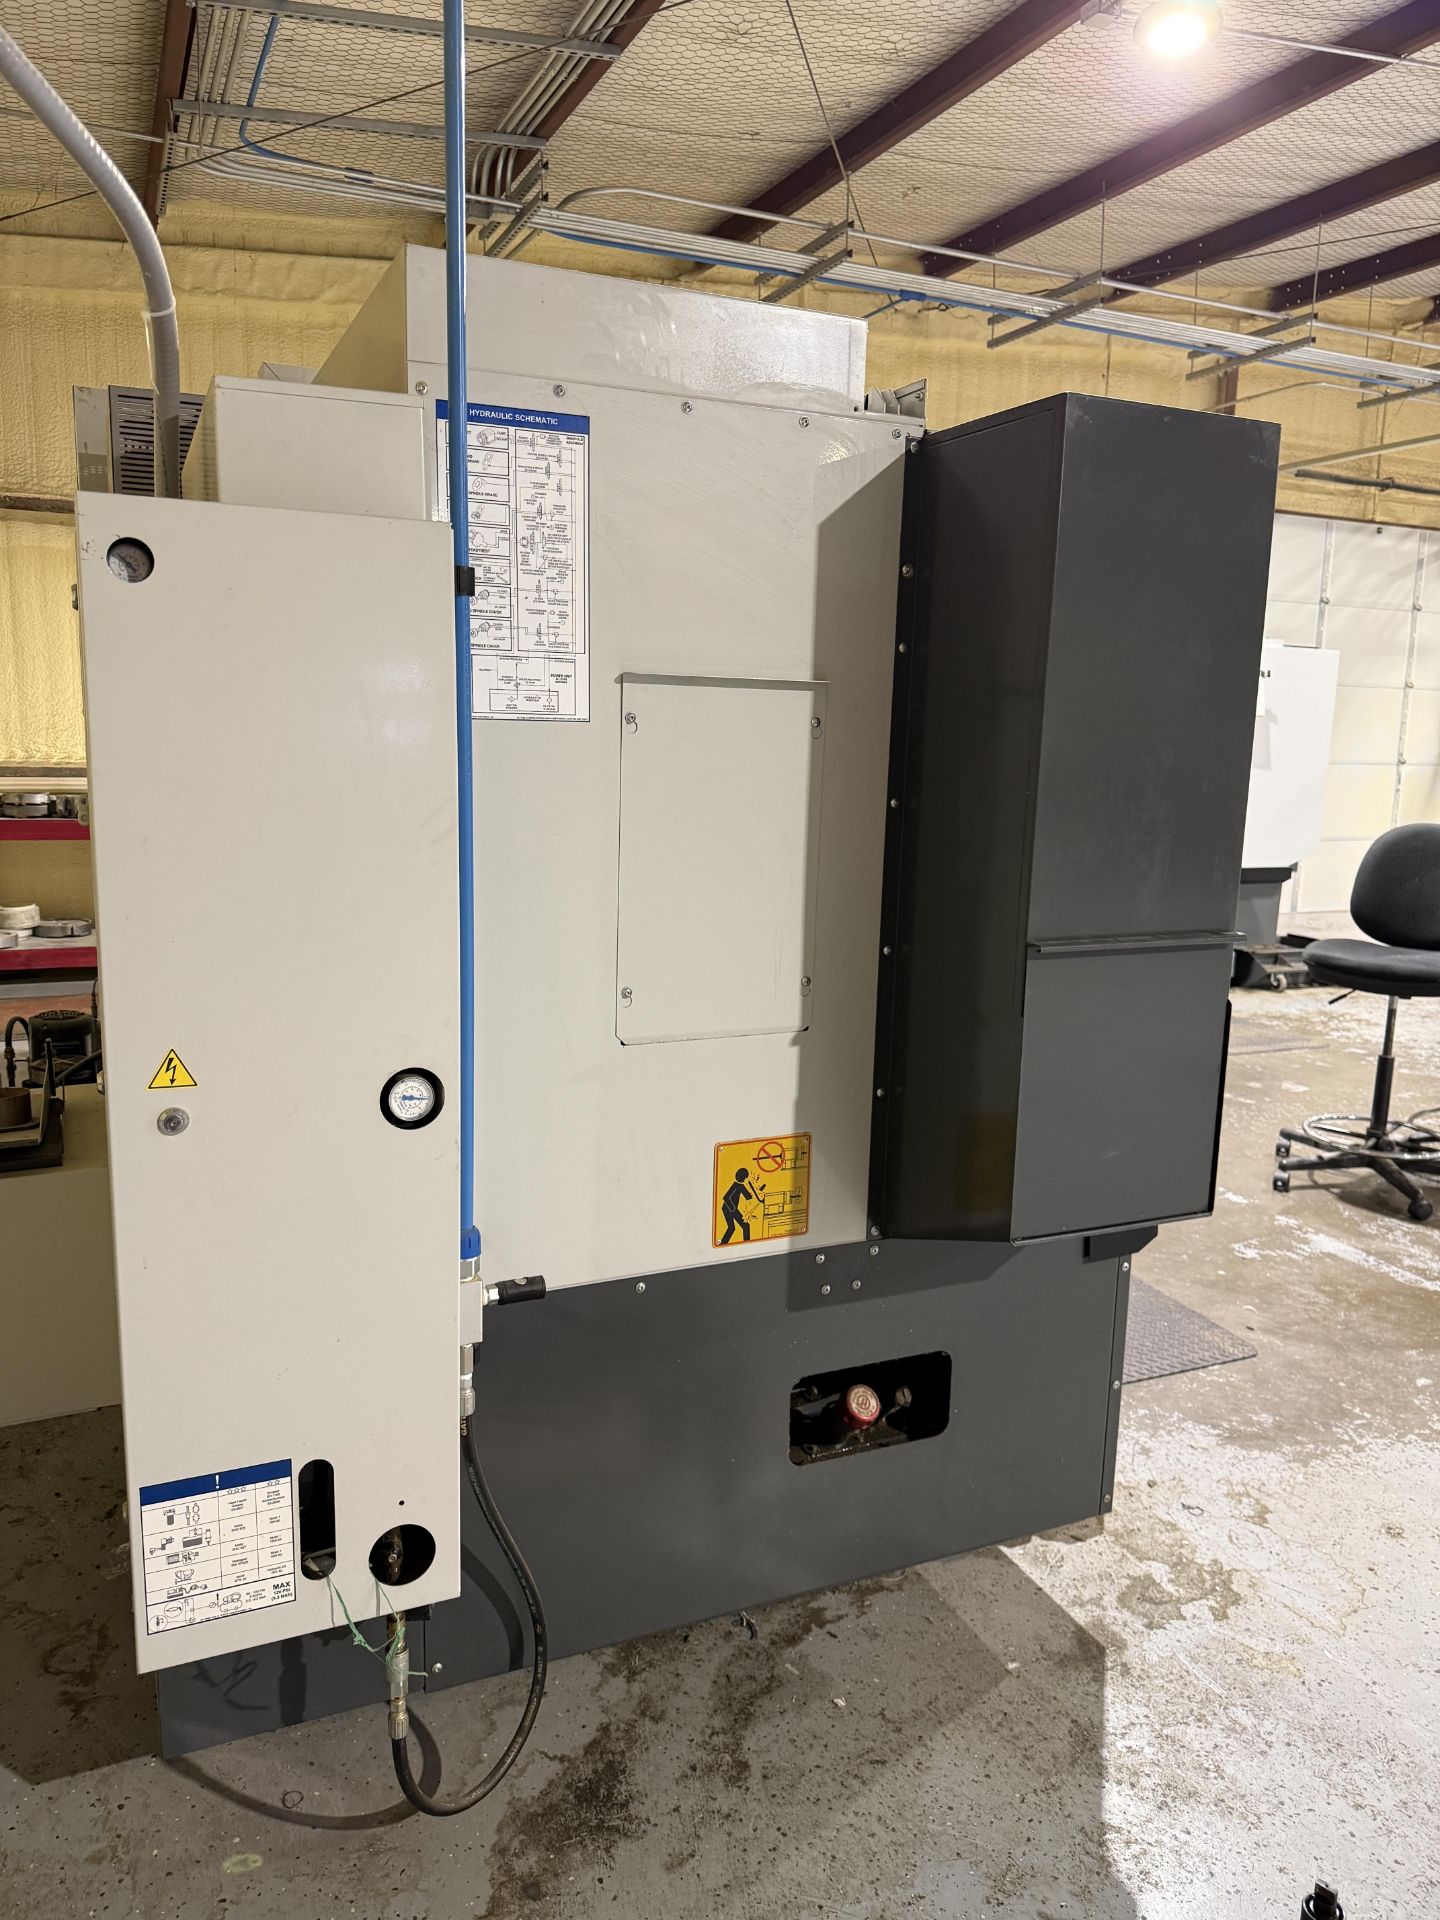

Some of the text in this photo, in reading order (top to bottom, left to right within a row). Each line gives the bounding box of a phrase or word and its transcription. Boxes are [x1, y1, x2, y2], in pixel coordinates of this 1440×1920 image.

[469, 408, 559, 425] HYDRAULIC SCHEMATIC
[272, 1581, 291, 1590] MAX
